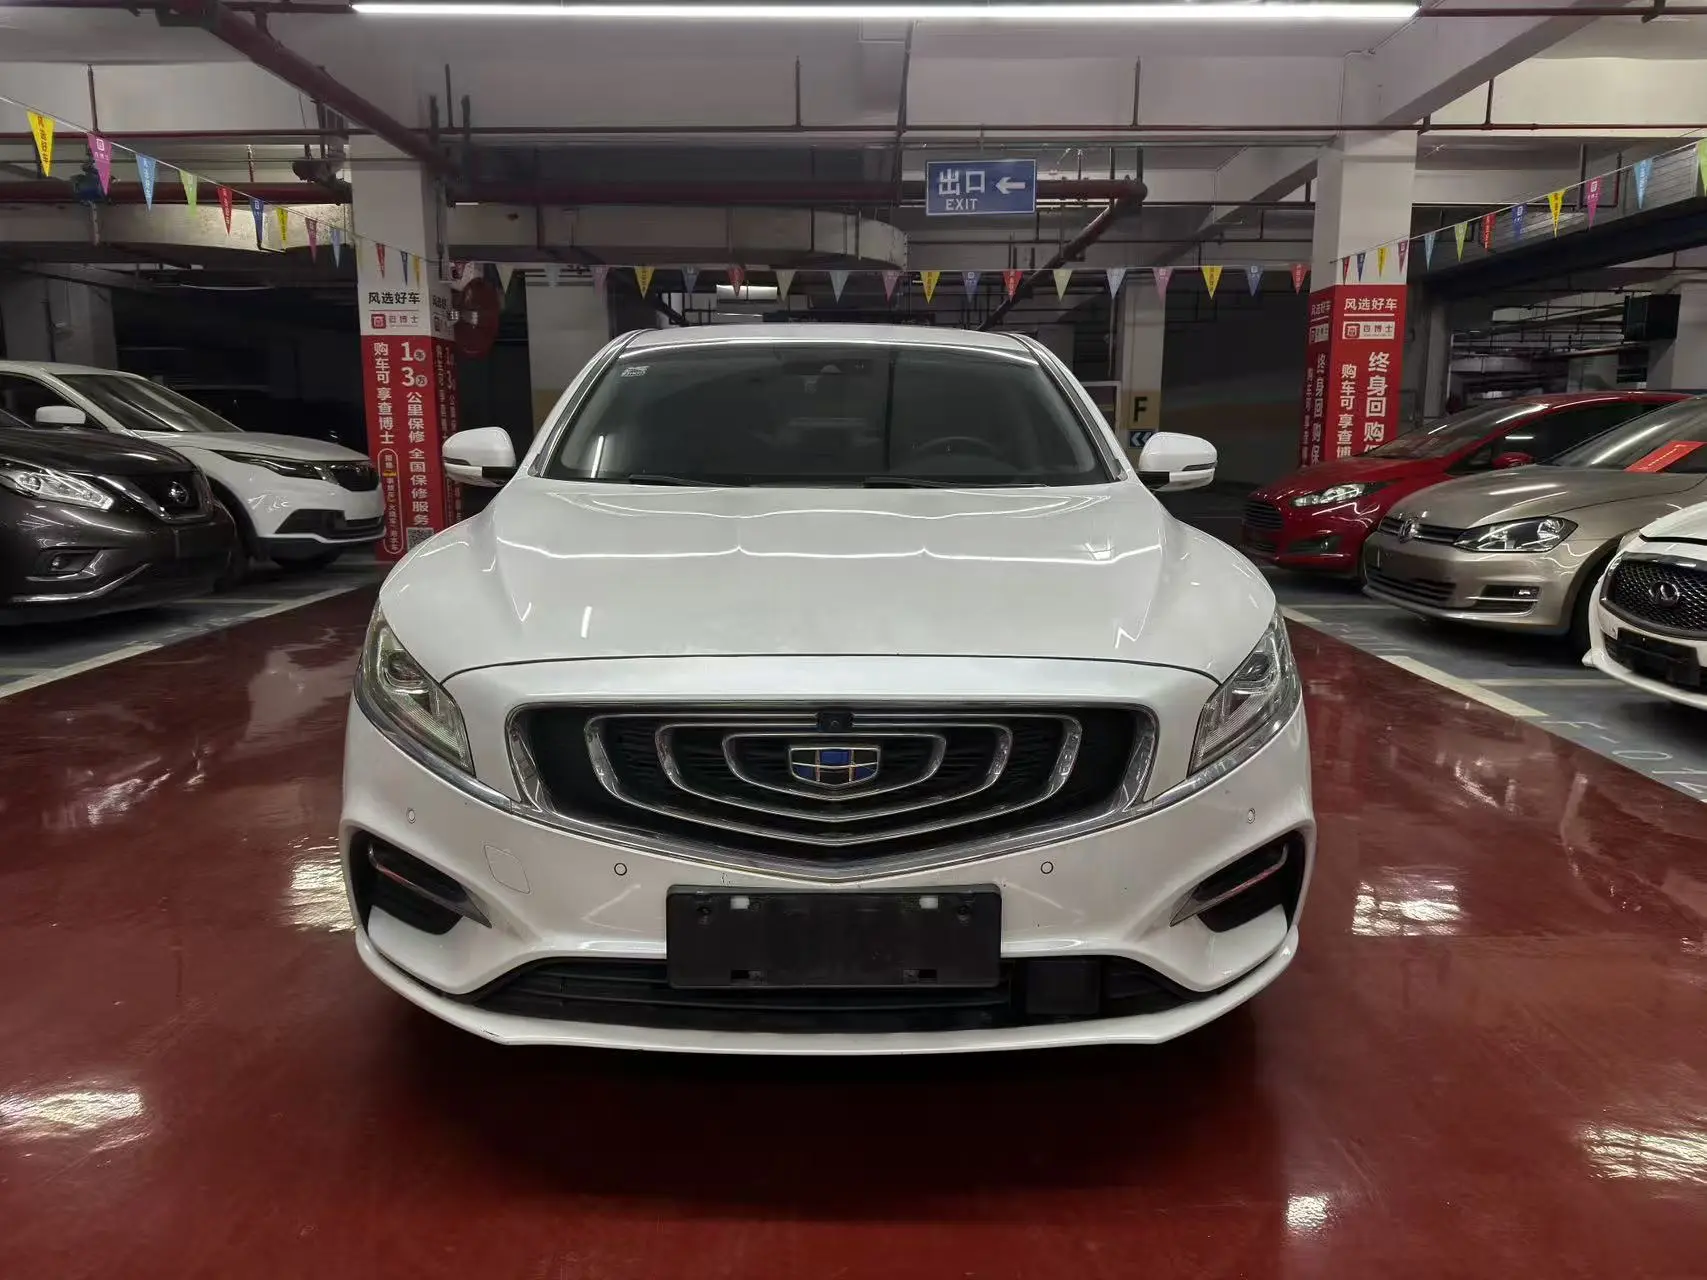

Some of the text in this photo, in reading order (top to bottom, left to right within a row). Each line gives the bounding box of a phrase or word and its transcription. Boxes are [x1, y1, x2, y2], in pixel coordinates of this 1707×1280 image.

[939, 168, 985, 195] 出口
[945, 198, 978, 211] EXIT
[368, 291, 420, 304] 风选好车
[1344, 298, 1397, 311] 风选好车
[1133, 396, 1148, 423] F
